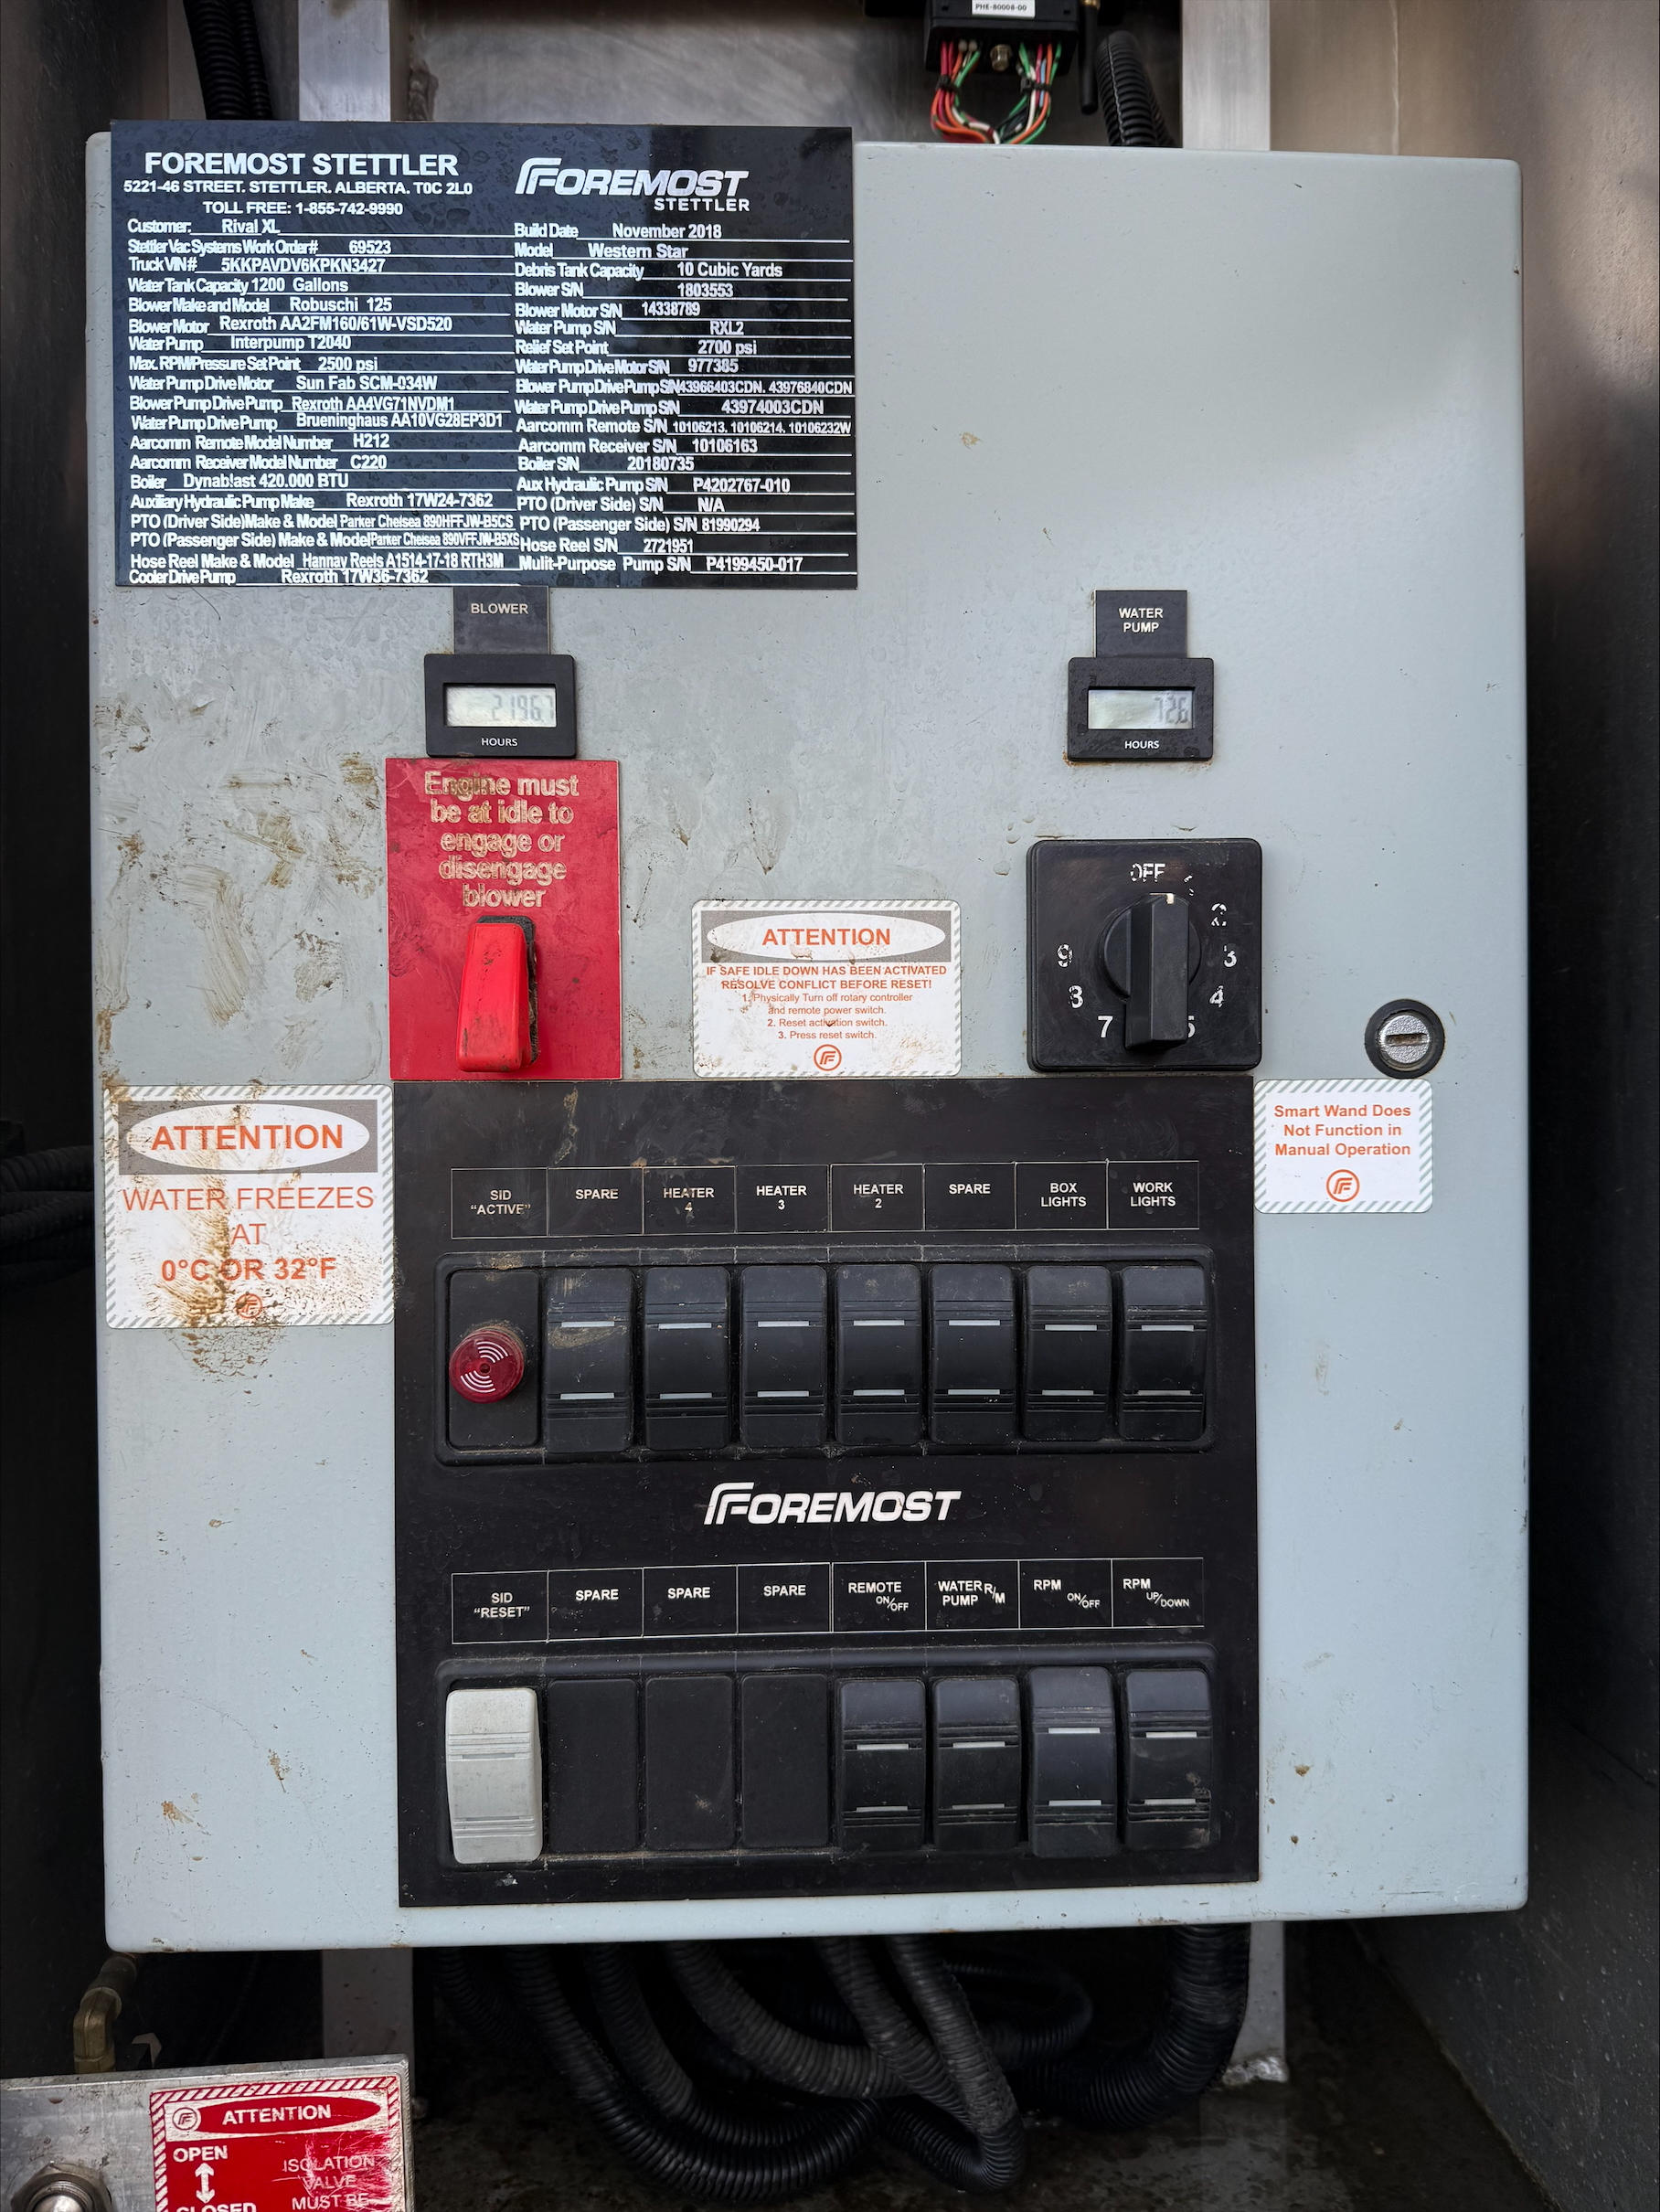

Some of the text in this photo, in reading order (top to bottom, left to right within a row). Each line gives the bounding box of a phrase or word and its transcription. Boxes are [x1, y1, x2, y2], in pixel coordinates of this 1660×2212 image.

[144, 152, 459, 175] FOREMOST STETTLER
[515, 157, 750, 197] FOREMOST
[123, 180, 179, 193] 5221-46
[203, 201, 404, 216] TOLL FREE: 1-855-742-9990
[654, 197, 750, 212] STETTLER
[221, 218, 259, 234] Rival
[261, 219, 281, 234] XL
[514, 223, 722, 239] Build Date November 2018
[348, 239, 391, 254] 69523
[514, 242, 689, 258] Model Western Star
[221, 258, 386, 272] 5KKPAVDV6KPKN3427
[677, 261, 783, 278] 10 Cubic Yards
[251, 277, 349, 292] 1200 Gallons
[677, 283, 733, 298] 1803553
[289, 296, 393, 312] Robuschi 125
[642, 302, 700, 316] 14338789
[219, 315, 452, 331] Rexroth AA2FM160/61W-VSD520
[709, 321, 744, 335] RXL2
[230, 335, 351, 352] Interpump T2040
[697, 339, 757, 356] 2700 psi
[318, 356, 378, 373] 2500 psi
[720, 399, 825, 415] 43974003CDN
[702, 517, 761, 532] 81990294
[470, 603, 528, 614] BLOWER
[1119, 608, 1164, 618] WATER
[1123, 622, 1159, 633] PUMP
[481, 738, 517, 747] HOURS
[1124, 740, 1159, 750] HOURS
[424, 771, 580, 802] Engine must
[431, 798, 574, 824] be at idle to
[441, 832, 565, 857] engage or
[439, 855, 567, 887] disengage
[1130, 863, 1165, 882] OFF
[463, 883, 546, 908] blower
[762, 929, 890, 946] ATTENTION
[706, 965, 947, 975] IF SAFE IDLE DOWN HAS BEEN ACTIVATED
[721, 980, 931, 989] RESOLVE CONFLICT BEFORE RESET!
[742, 993, 913, 1004] 1. Physically Turn off rotary controller
[1209, 985, 1224, 1007] 4
[768, 1005, 887, 1016] and remote power switch.
[767, 1018, 888, 1027] 2. Reset activation switch.
[1097, 1015, 1113, 1038] 7
[779, 1031, 786, 1039] 3.
[790, 1031, 817, 1039] Press
[819, 1031, 843, 1039] reset
[1274, 1104, 1411, 1117] Smart Wand Does
[151, 1124, 344, 1151] ATTENTION
[1283, 1124, 1402, 1137] Not Function in
[1274, 1143, 1411, 1157] Manual Operation
[576, 1188, 619, 1199] SPARE
[663, 1188, 715, 1198] HEATER
[756, 1185, 806, 1196] HEATER
[853, 1183, 903, 1196] HEATER
[949, 1183, 991, 1195] SPARE
[1049, 1182, 1077, 1194] BOX
[1133, 1181, 1173, 1194] WORK
[122, 1186, 375, 1210] WATER FREEZES
[490, 1190, 512, 1201] SID
[874, 1197, 882, 1208] 2
[1040, 1196, 1086, 1207] LIGHTS
[1130, 1196, 1176, 1207] LIGHTS
[685, 1201, 693, 1212] 4
[777, 1199, 786, 1210] 3
[230, 1223, 267, 1245] AT
[220, 1259, 264, 1281] OR
[274, 1258, 336, 1280] 32°F
[704, 1483, 962, 1525] FOREMOST
[848, 1581, 902, 1594] REMOTE
[938, 1580, 983, 1592] WATER
[1033, 1579, 1062, 1590] RPM
[1123, 1578, 1151, 1590] RPM
[491, 1592, 514, 1603] SID
[575, 1589, 620, 1601] SPARE
[667, 1587, 711, 1600] SPARE
[763, 1585, 806, 1598] SPARE
[876, 1596, 909, 1611] ON/OFF
[942, 1594, 978, 1607] PUMP
[1067, 1592, 1101, 1609] ON/OFF
[1146, 1591, 1190, 1608] UP/DOWN
[222, 2104, 332, 2126] ATTENTION
[173, 2145, 229, 2163] OPEN
[283, 2155, 375, 2172] ISOLATION
[302, 2174, 356, 2191] VALVE
[292, 2192, 368, 2211] MUST BE
